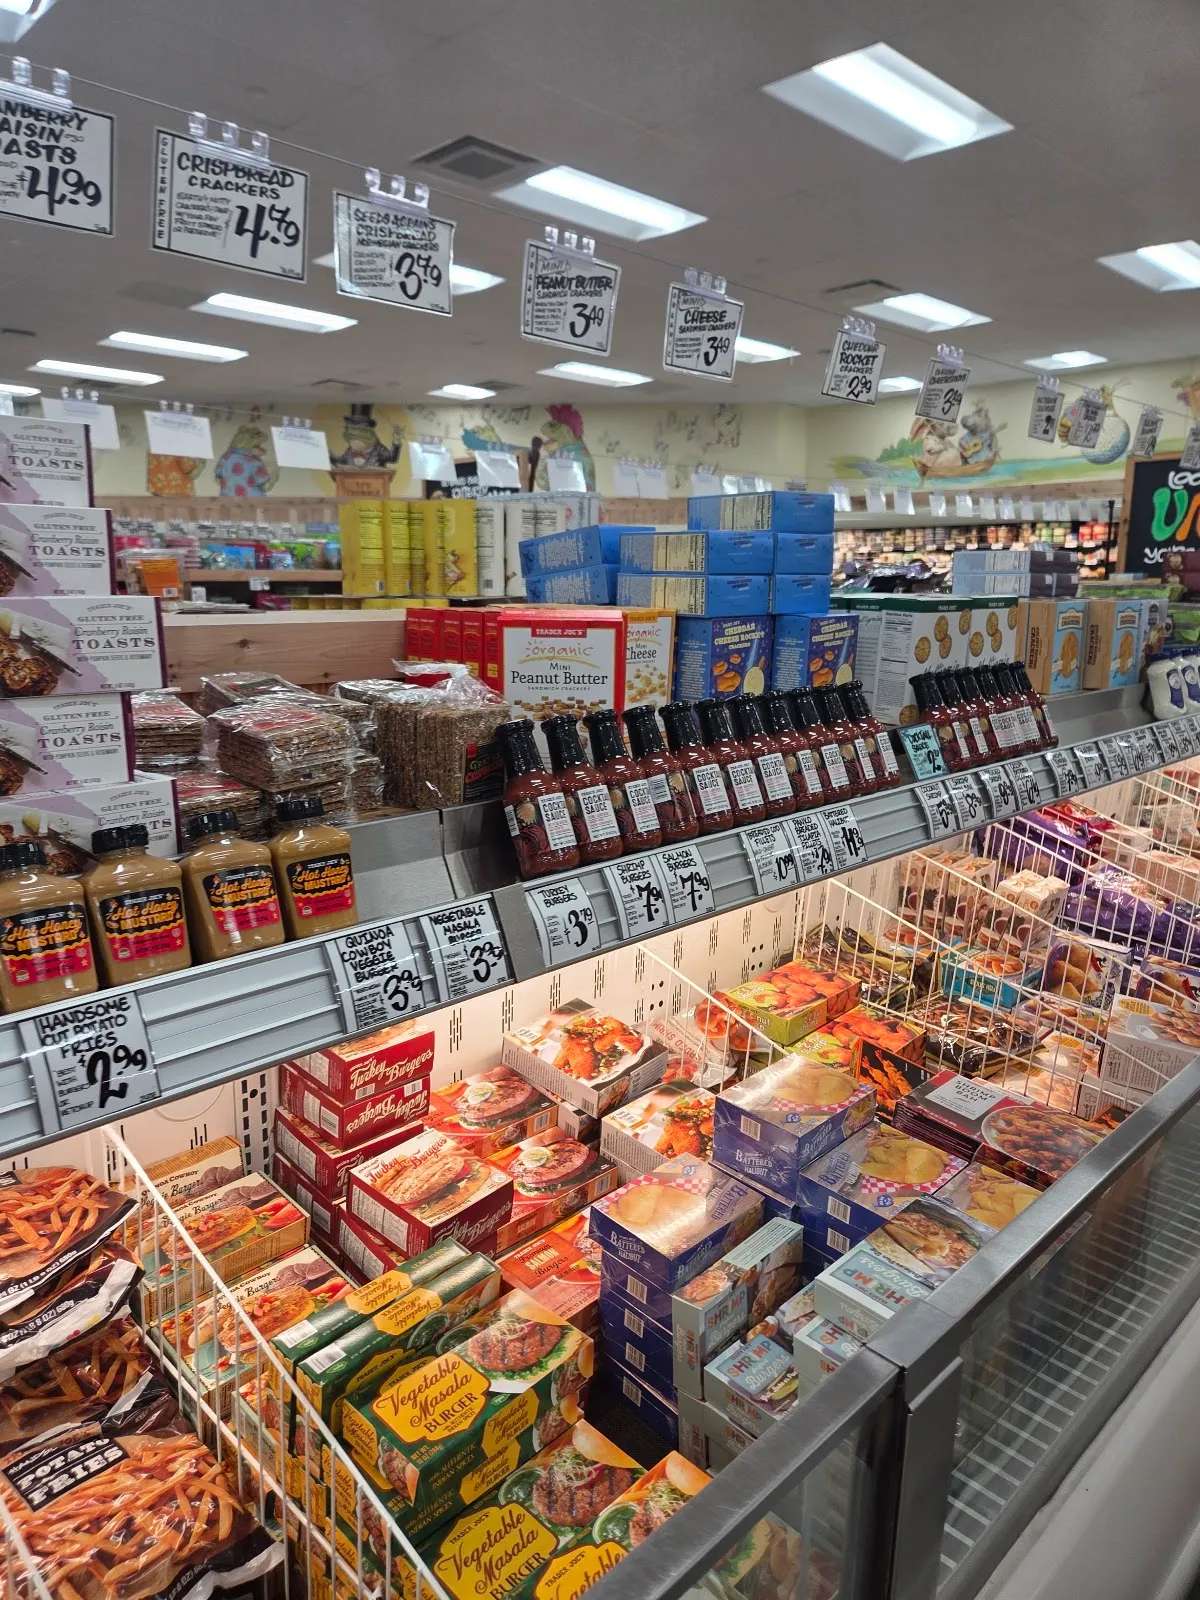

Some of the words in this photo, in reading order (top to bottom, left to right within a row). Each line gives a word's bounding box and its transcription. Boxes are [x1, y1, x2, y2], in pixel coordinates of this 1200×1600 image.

[177, 152, 294, 188] CRISPBREAD
[188, 175, 281, 200] CRACKERS
[354, 208, 390, 225] SEEDS
[536, 275, 575, 290] PEANUT
[575, 275, 613, 291] BUTTER
[684, 310, 727, 324] CHEESE
[839, 352, 878, 367] ROCKET
[8, 455, 85, 471] TOASTS
[29, 545, 106, 557] TOASTS
[77, 615, 117, 623] GLUTEN
[119, 614, 145, 622] FREE
[821, 622, 848, 633] CHEDDAR
[74, 624, 120, 638] Cranberry
[121, 626, 149, 636] Raisin
[536, 628, 562, 636] TRADER
[563, 628, 584, 636] JOE'S
[725, 623, 756, 636] CHEDDAR
[812, 633, 834, 643] CHEESE
[72, 637, 156, 650] TOASTS
[714, 634, 740, 646] CHEESE
[532, 643, 595, 661] organic
[625, 648, 657, 661] Cheese
[511, 671, 560, 684] Peanut
[563, 672, 608, 685] Butter
[43, 713, 83, 722] GLUTEN
[84, 710, 111, 719] FREE
[40, 723, 86, 737] Cranberry
[87, 722, 115, 733] Raisin
[37, 732, 122, 749] TOASTS
[734, 775, 753, 785] SAUCE
[763, 769, 783, 778] SAUCE
[699, 780, 720, 790] SAUCE
[100, 801, 138, 812] GLUTEN
[139, 798, 162, 807] FREE
[141, 809, 166, 820] Raisin
[585, 802, 608, 815] SAUCE
[823, 808, 848, 820] BATTERED
[545, 810, 567, 822] SAUCE
[755, 834, 776, 847] FILLETS
[662, 849, 693, 863] SALMON
[667, 858, 697, 872] BURGERS
[297, 869, 320, 883] Hot
[321, 865, 350, 877] Honey
[616, 860, 645, 875] SHRIMP
[215, 881, 240, 896] Hot
[241, 878, 272, 891] Honey
[304, 876, 347, 891] MUSTARD
[620, 870, 651, 885] BURGERS
[223, 887, 271, 903] MUSTARD
[537, 884, 570, 899] TURKEY
[543, 893, 578, 908] BURGERS
[112, 906, 141, 921] Hot
[142, 901, 178, 916] Honey
[120, 911, 175, 930] MUSTARD
[429, 904, 486, 926] VEGETABLE
[8, 925, 38, 942] Hot
[40, 919, 83, 935] Honey
[345, 925, 395, 948] QUINOA
[442, 918, 481, 936] MASALA
[17, 931, 79, 951] MUSTARD
[341, 939, 393, 963] COWBOY
[350, 950, 395, 972] VEGGIE
[39, 996, 131, 1034] HANDSOME
[41, 1028, 70, 1046] CUT
[73, 1013, 128, 1036] POTATO
[60, 1031, 118, 1058] FRIES
[350, 1059, 387, 1090] Turkey
[385, 1050, 433, 1085] Burgers
[955, 1080, 997, 1100] SHRIMP
[955, 1085, 988, 1102] BOOM
[956, 1090, 978, 1103] BAH
[346, 1094, 395, 1134] Burgers
[394, 1090, 428, 1120] Turkey
[365, 1156, 402, 1183] Turkey
[404, 1137, 447, 1170] Burgers
[736, 1149, 773, 1168] BATTERED
[169, 1170, 199, 1182] COWBOY
[744, 1166, 768, 1176] HALIBUT
[818, 1152, 851, 1185] BATTERED
[170, 1179, 204, 1198] Burgers
[711, 1184, 749, 1221] BATTERED
[466, 1201, 512, 1246] Burgers
[610, 1231, 645, 1254] BATTERED
[519, 1244, 552, 1264] Premium
[525, 1247, 560, 1271] SALMON
[618, 1249, 642, 1263] HALIBUT
[535, 1256, 569, 1278] Burgers
[239, 1272, 271, 1288] COWBOY
[244, 1275, 281, 1298] Burgers
[361, 1278, 393, 1299] Masala
[364, 1283, 411, 1309] Vegetable
[390, 1296, 422, 1321] Masala
[394, 1301, 441, 1329] Vegetable
[708, 1290, 746, 1329] SHRIMP
[727, 1340, 772, 1378] SHRIMP
[356, 1366, 379, 1382] TRADER
[389, 1372, 413, 1388] TRADER
[746, 1354, 790, 1391] Burgers
[376, 1359, 461, 1416] Vegetable
[410, 1372, 473, 1428] Masala
[423, 1392, 480, 1434] BURGER
[487, 1397, 529, 1429] Vegetable
[343, 1405, 377, 1443] Vegetable
[495, 1410, 528, 1445] Masala
[505, 1419, 530, 1442] BURGER
[346, 1424, 375, 1452] Masala
[15, 1438, 110, 1491] POTATO
[28, 1446, 124, 1506] FRIES
[486, 1465, 511, 1487] BURGER
[449, 1525, 472, 1544] TRADER
[473, 1512, 491, 1528] JOE'S
[437, 1509, 526, 1582] Vegetable
[474, 1527, 539, 1596] Masala
[545, 1566, 569, 1588] TRADER
[568, 1551, 586, 1568] JOE'S
[489, 1551, 547, 1600] BURGER
